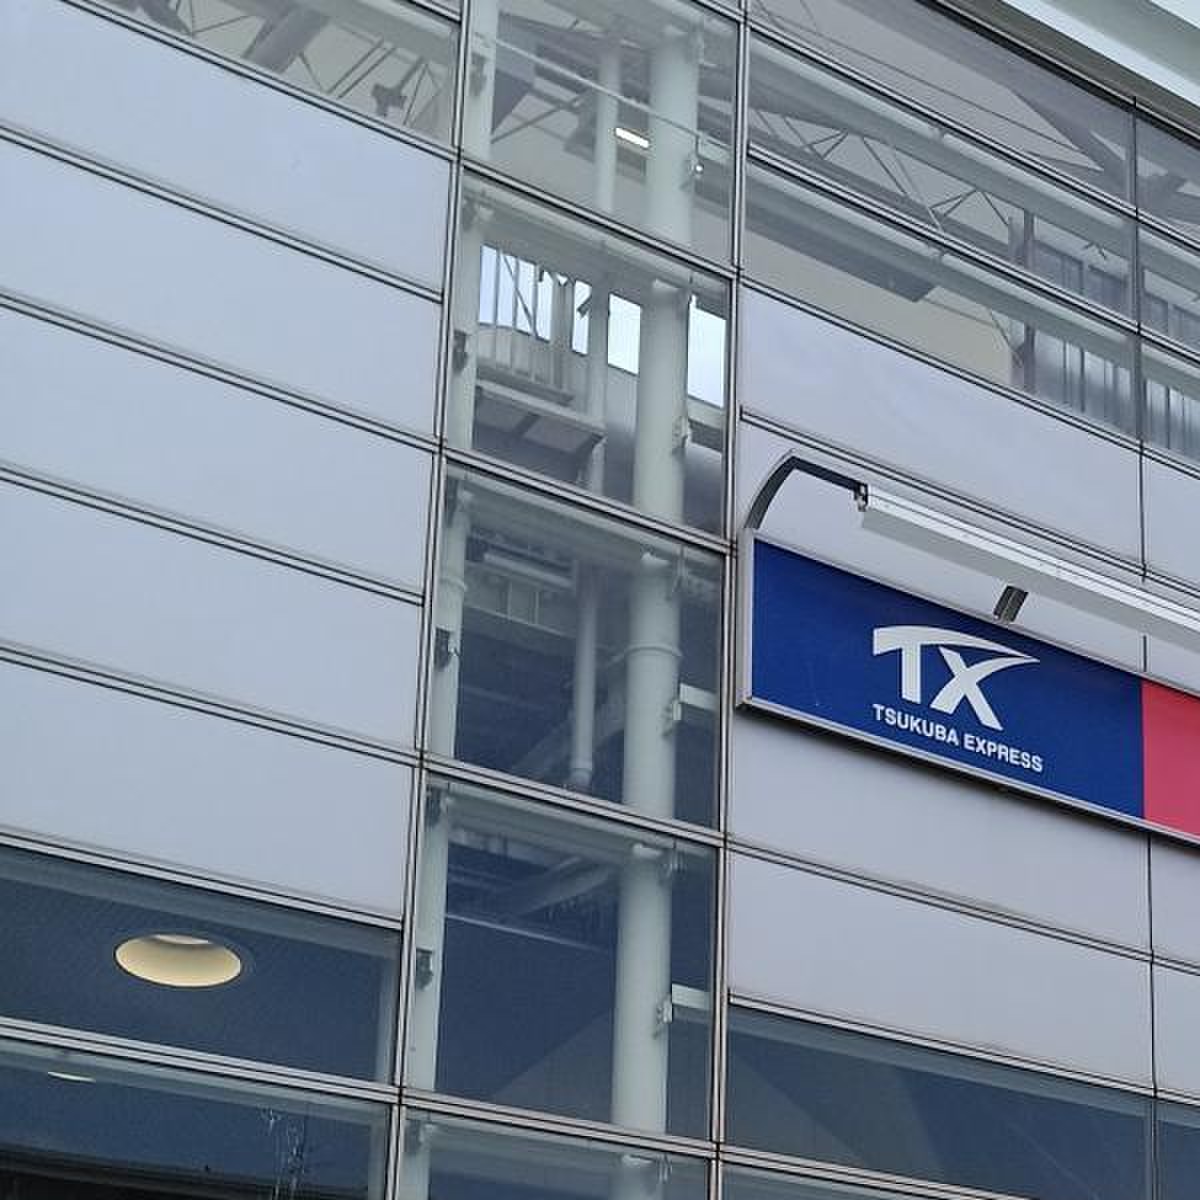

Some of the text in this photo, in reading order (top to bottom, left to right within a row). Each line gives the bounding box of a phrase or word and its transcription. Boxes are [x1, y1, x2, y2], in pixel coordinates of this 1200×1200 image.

[872, 625, 1041, 731] TX
[872, 703, 1044, 773] TSUKUBA EXPRESS
